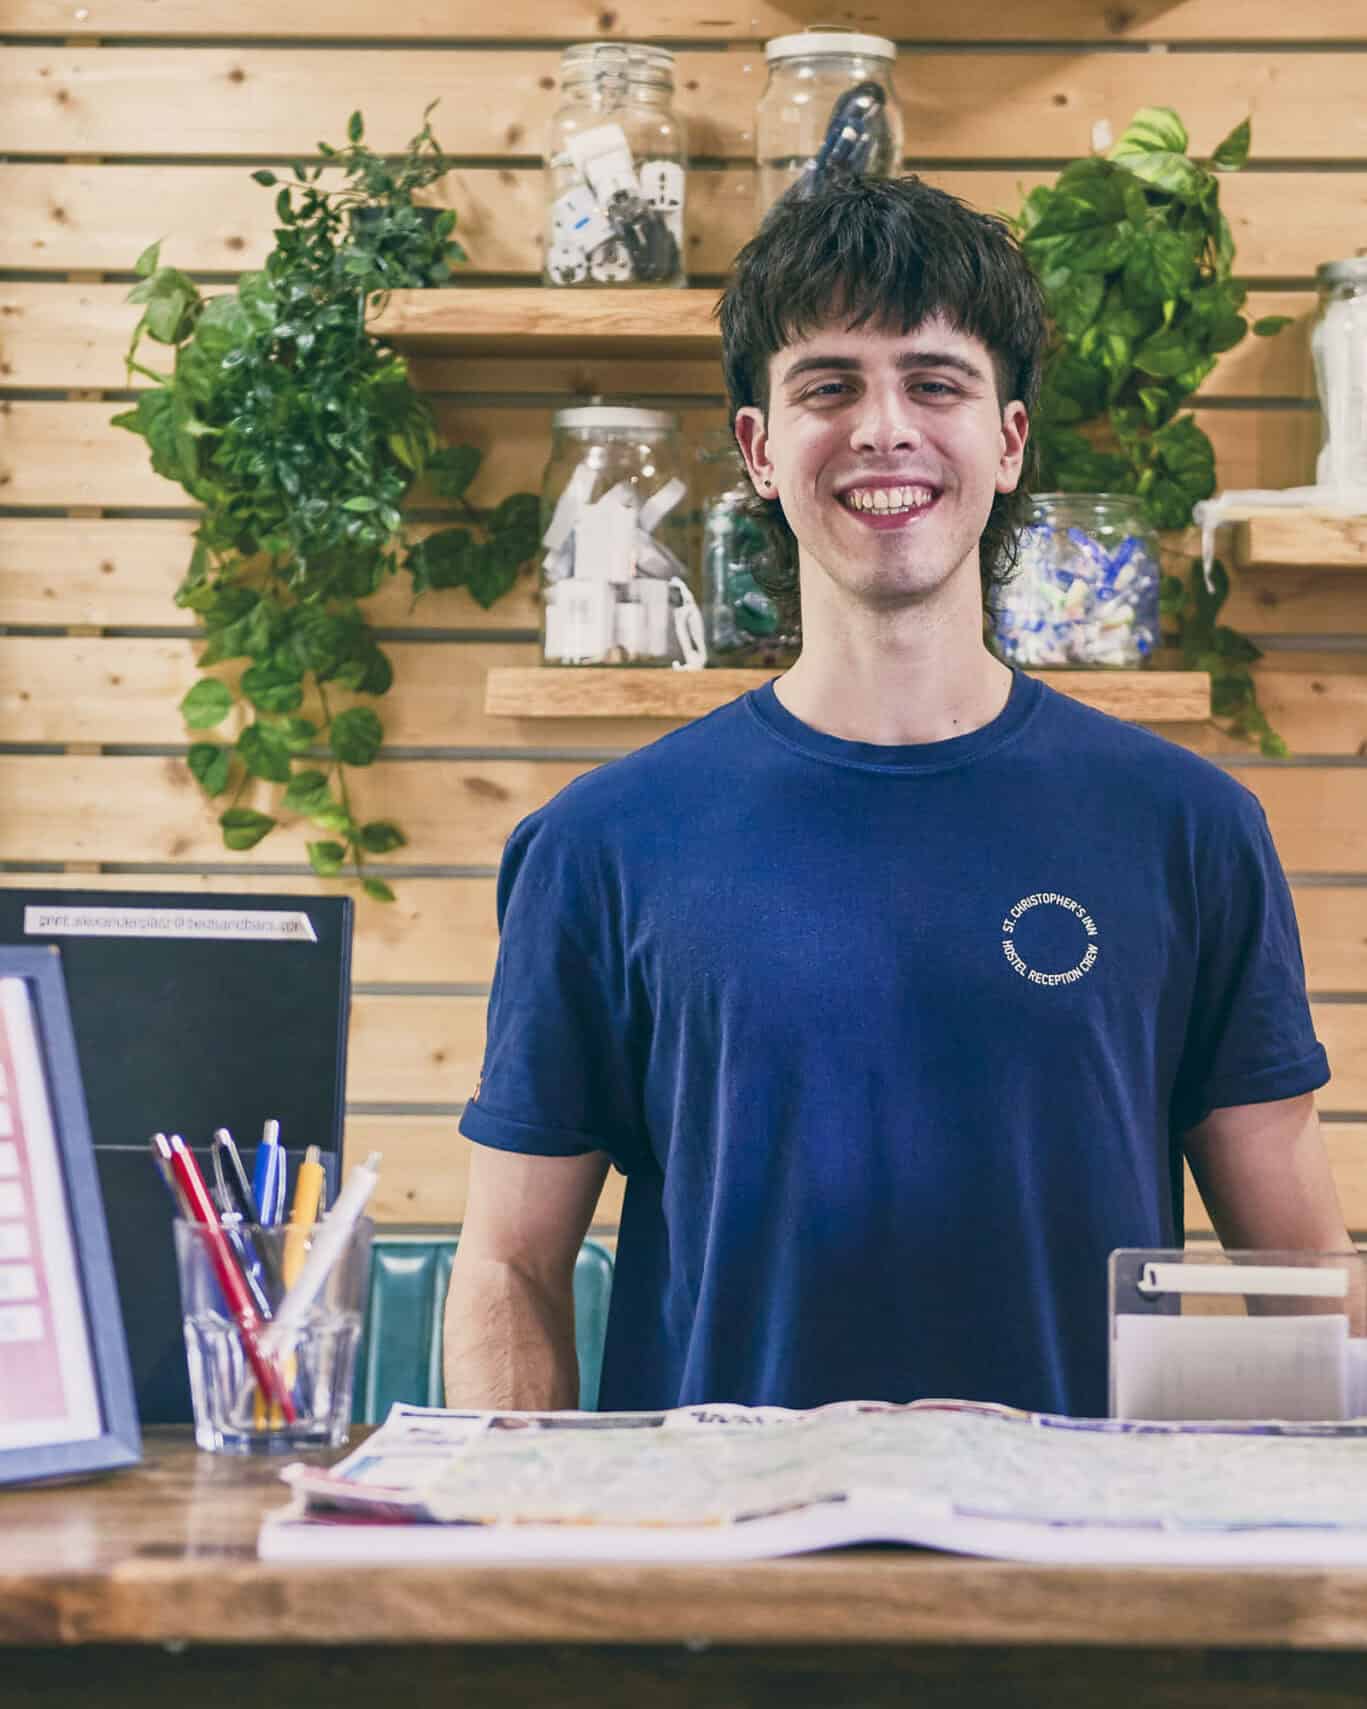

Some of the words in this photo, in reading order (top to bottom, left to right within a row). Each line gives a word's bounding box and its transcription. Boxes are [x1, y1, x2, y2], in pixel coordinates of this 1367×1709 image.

[1002, 918, 1016, 933] ST.
[1010, 893, 1086, 918] CHRISTOPHER'S
[1081, 916, 1098, 936] INN
[1002, 940, 1027, 976] HOSTEL
[1028, 966, 1083, 985] RECEPTION
[1080, 943, 1098, 972] CREW
